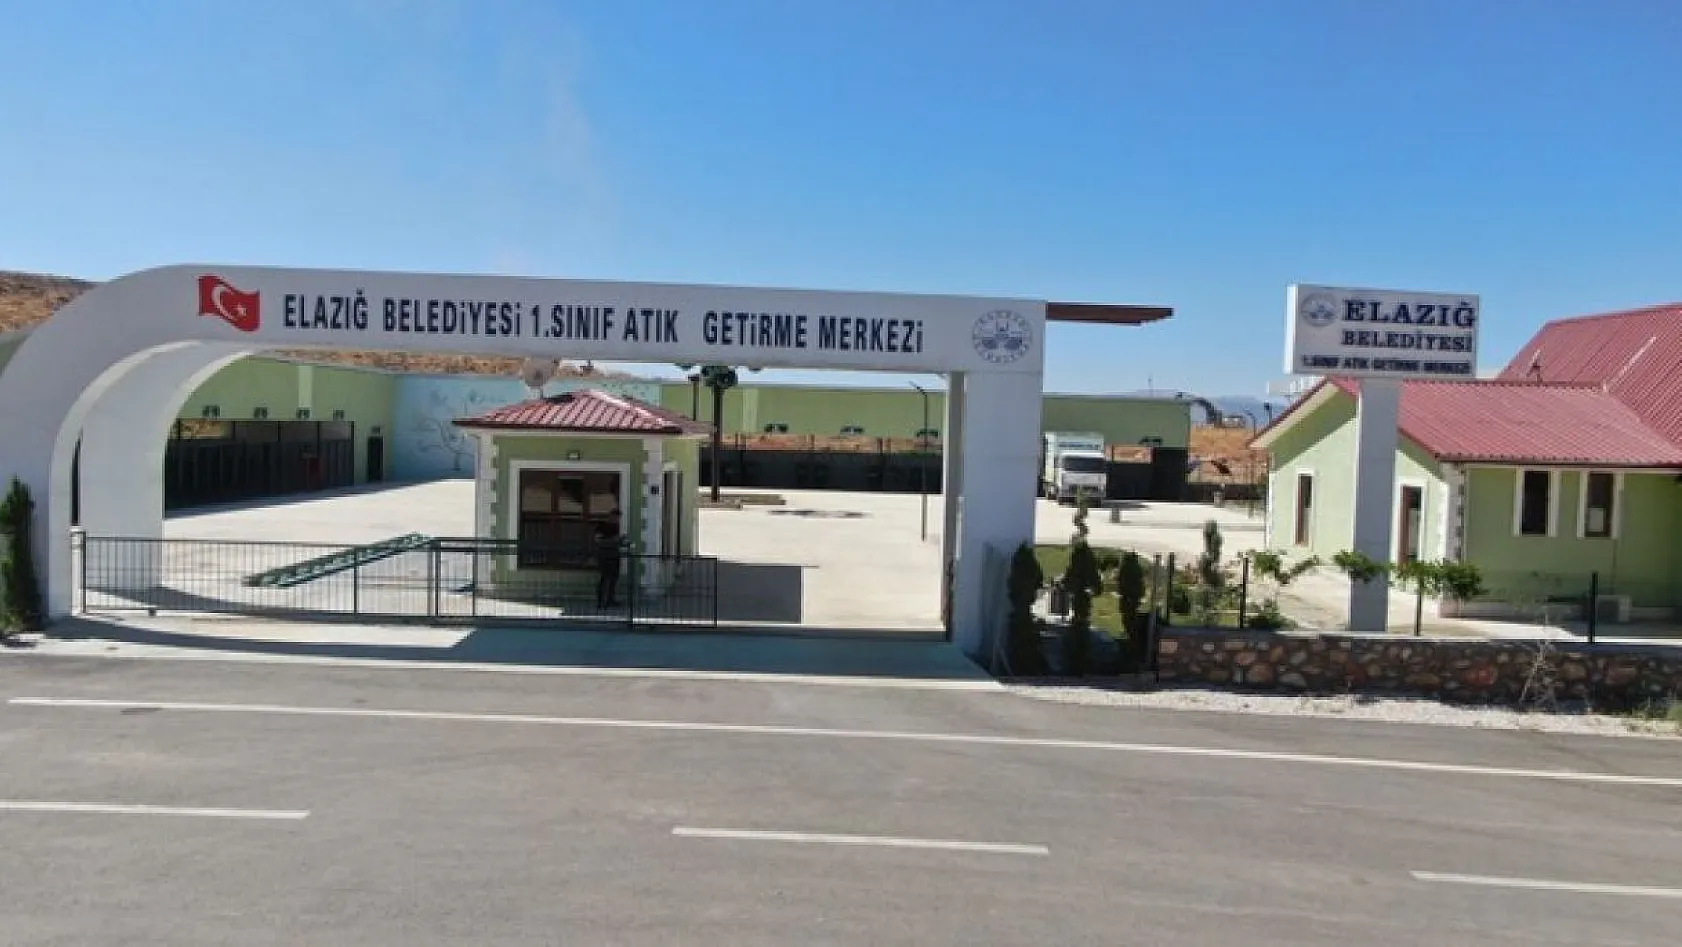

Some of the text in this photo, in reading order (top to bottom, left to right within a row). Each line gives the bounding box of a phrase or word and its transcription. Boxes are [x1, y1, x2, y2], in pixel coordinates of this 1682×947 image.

[283, 288, 368, 330] ELAZIĞ
[531, 305, 615, 341] 1.SINIF
[623, 308, 679, 343] ATIK
[1343, 298, 1475, 327] ELAZIĞ
